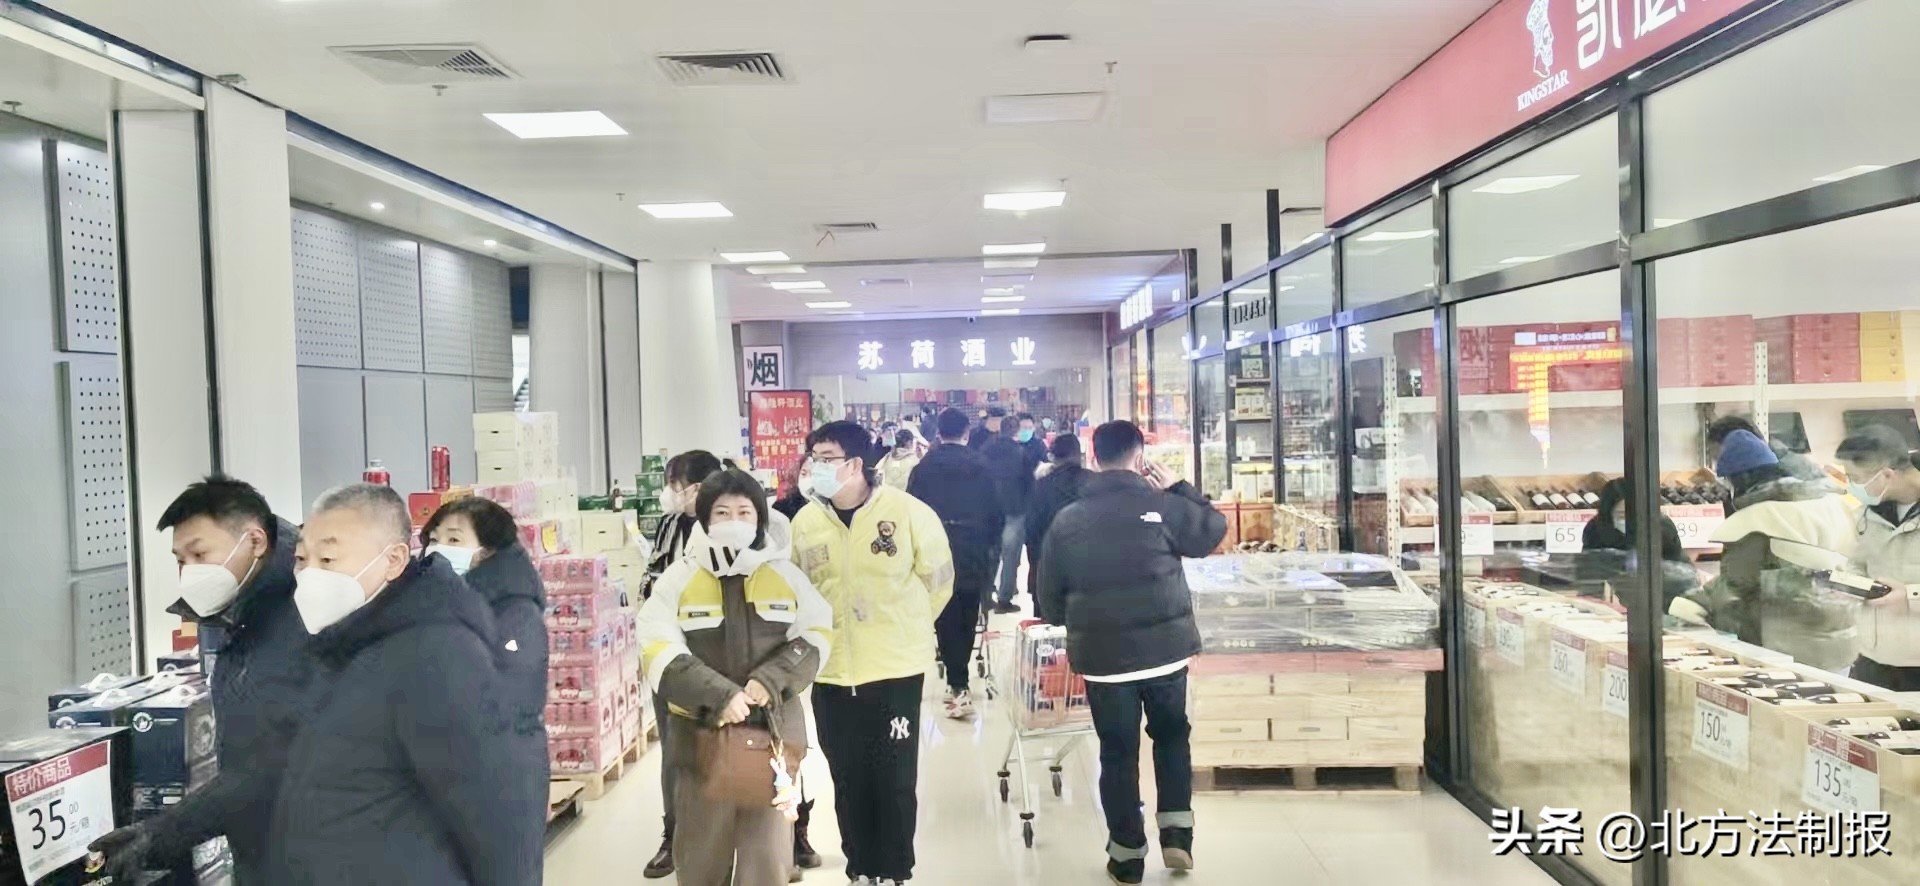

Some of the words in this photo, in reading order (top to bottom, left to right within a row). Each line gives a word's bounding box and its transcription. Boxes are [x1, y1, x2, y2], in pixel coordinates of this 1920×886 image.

[1517, 69, 1570, 112] KINGSTAR
[751, 352, 779, 387] 烟
[858, 336, 1037, 370] 苏荷酒业
[1554, 527, 1577, 543] 65
[1553, 649, 1569, 673] 260
[1609, 674, 1628, 701] 200
[889, 716, 910, 740] NY
[1700, 711, 1721, 742] 150
[12, 756, 72, 797] 特价商品
[1814, 758, 1842, 797] 135
[28, 798, 66, 850] 35
